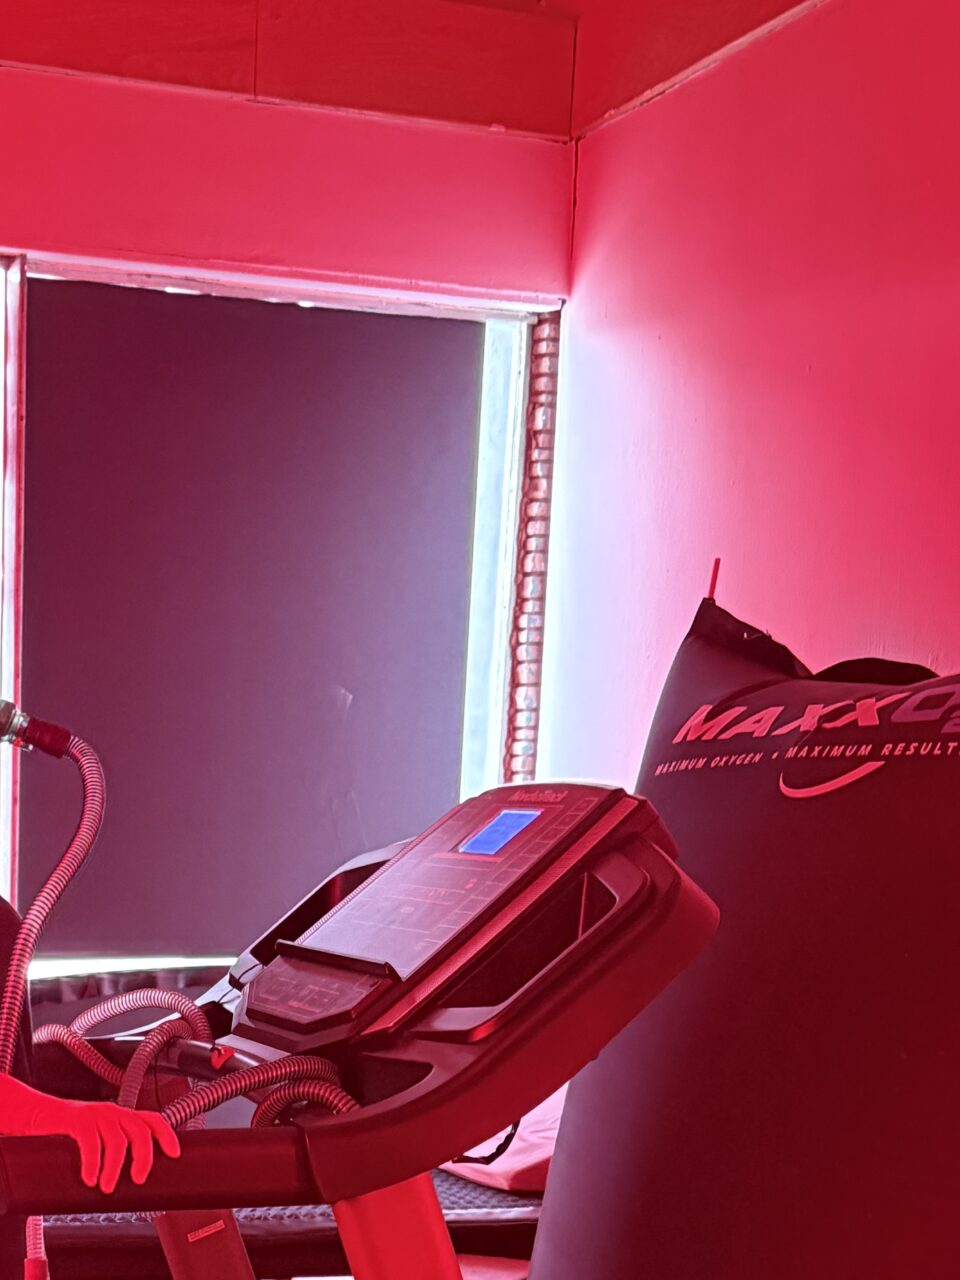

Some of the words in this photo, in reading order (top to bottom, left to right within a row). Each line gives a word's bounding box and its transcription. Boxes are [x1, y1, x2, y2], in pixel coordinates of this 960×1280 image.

[655, 757, 707, 776] MAXIMUM
[711, 752, 763, 768] OXYGEN
[785, 744, 872, 759] MAXIMUM
[880, 742, 960, 756] RESULT
